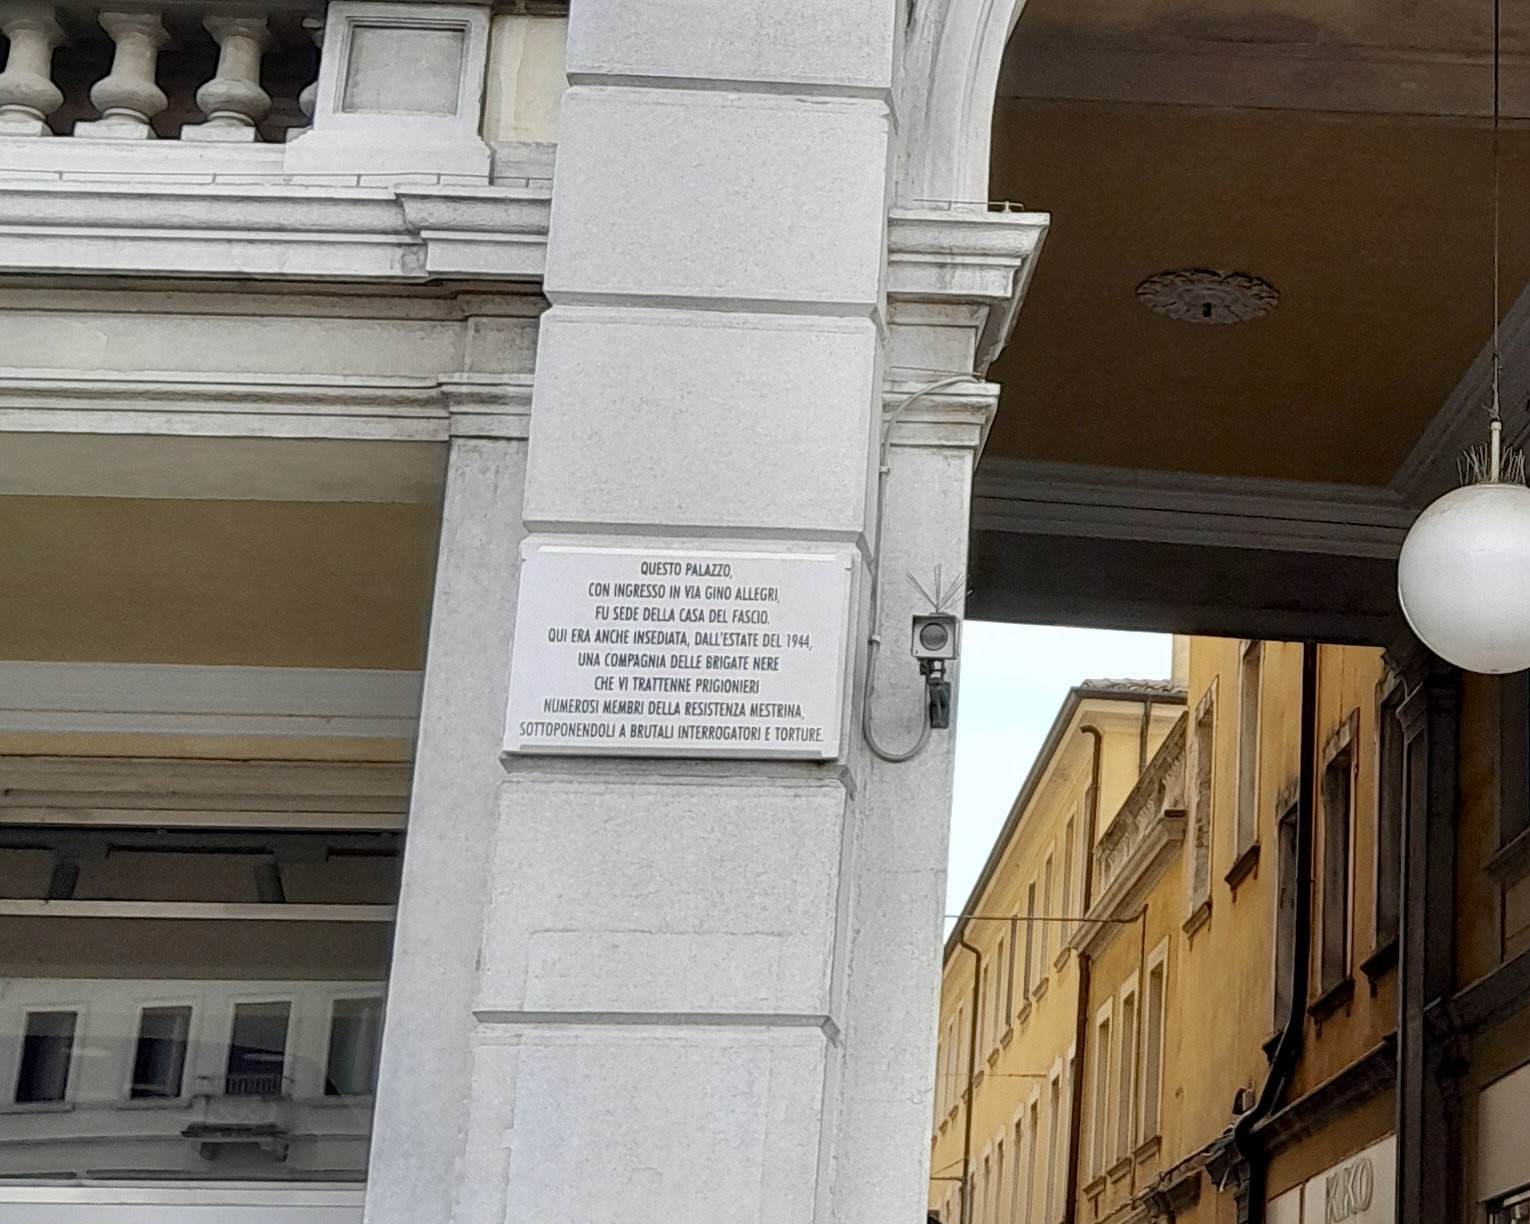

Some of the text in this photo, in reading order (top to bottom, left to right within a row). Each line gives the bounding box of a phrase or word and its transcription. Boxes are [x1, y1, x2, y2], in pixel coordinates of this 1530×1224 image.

[640, 561, 733, 579] QUESTO PALAZZO,
[588, 582, 780, 604] CON INGRESSO IN VIA GINO ALLEGRI,
[595, 606, 770, 625] FU SEDE DELLA CASA DEL FASCIO.
[548, 628, 813, 651] QUI ERA ANCHE INSEDIATA, DALL'ESTATE DEL 1944,
[578, 652, 780, 671] UNA COMPAGNIA DELLE BRIGATE NERE
[594, 675, 760, 694] CHE VI TRATTENNE PRIGIONIERI
[543, 698, 599, 714] NUMEROSI
[602, 699, 644, 715] MEMBRI
[648, 700, 680, 715] DELLA
[685, 702, 746, 717] RESISTENZA
[519, 721, 824, 742] SOTTOPONENDOLI A BRUTALI INTERROGATORI E TORTURE.
